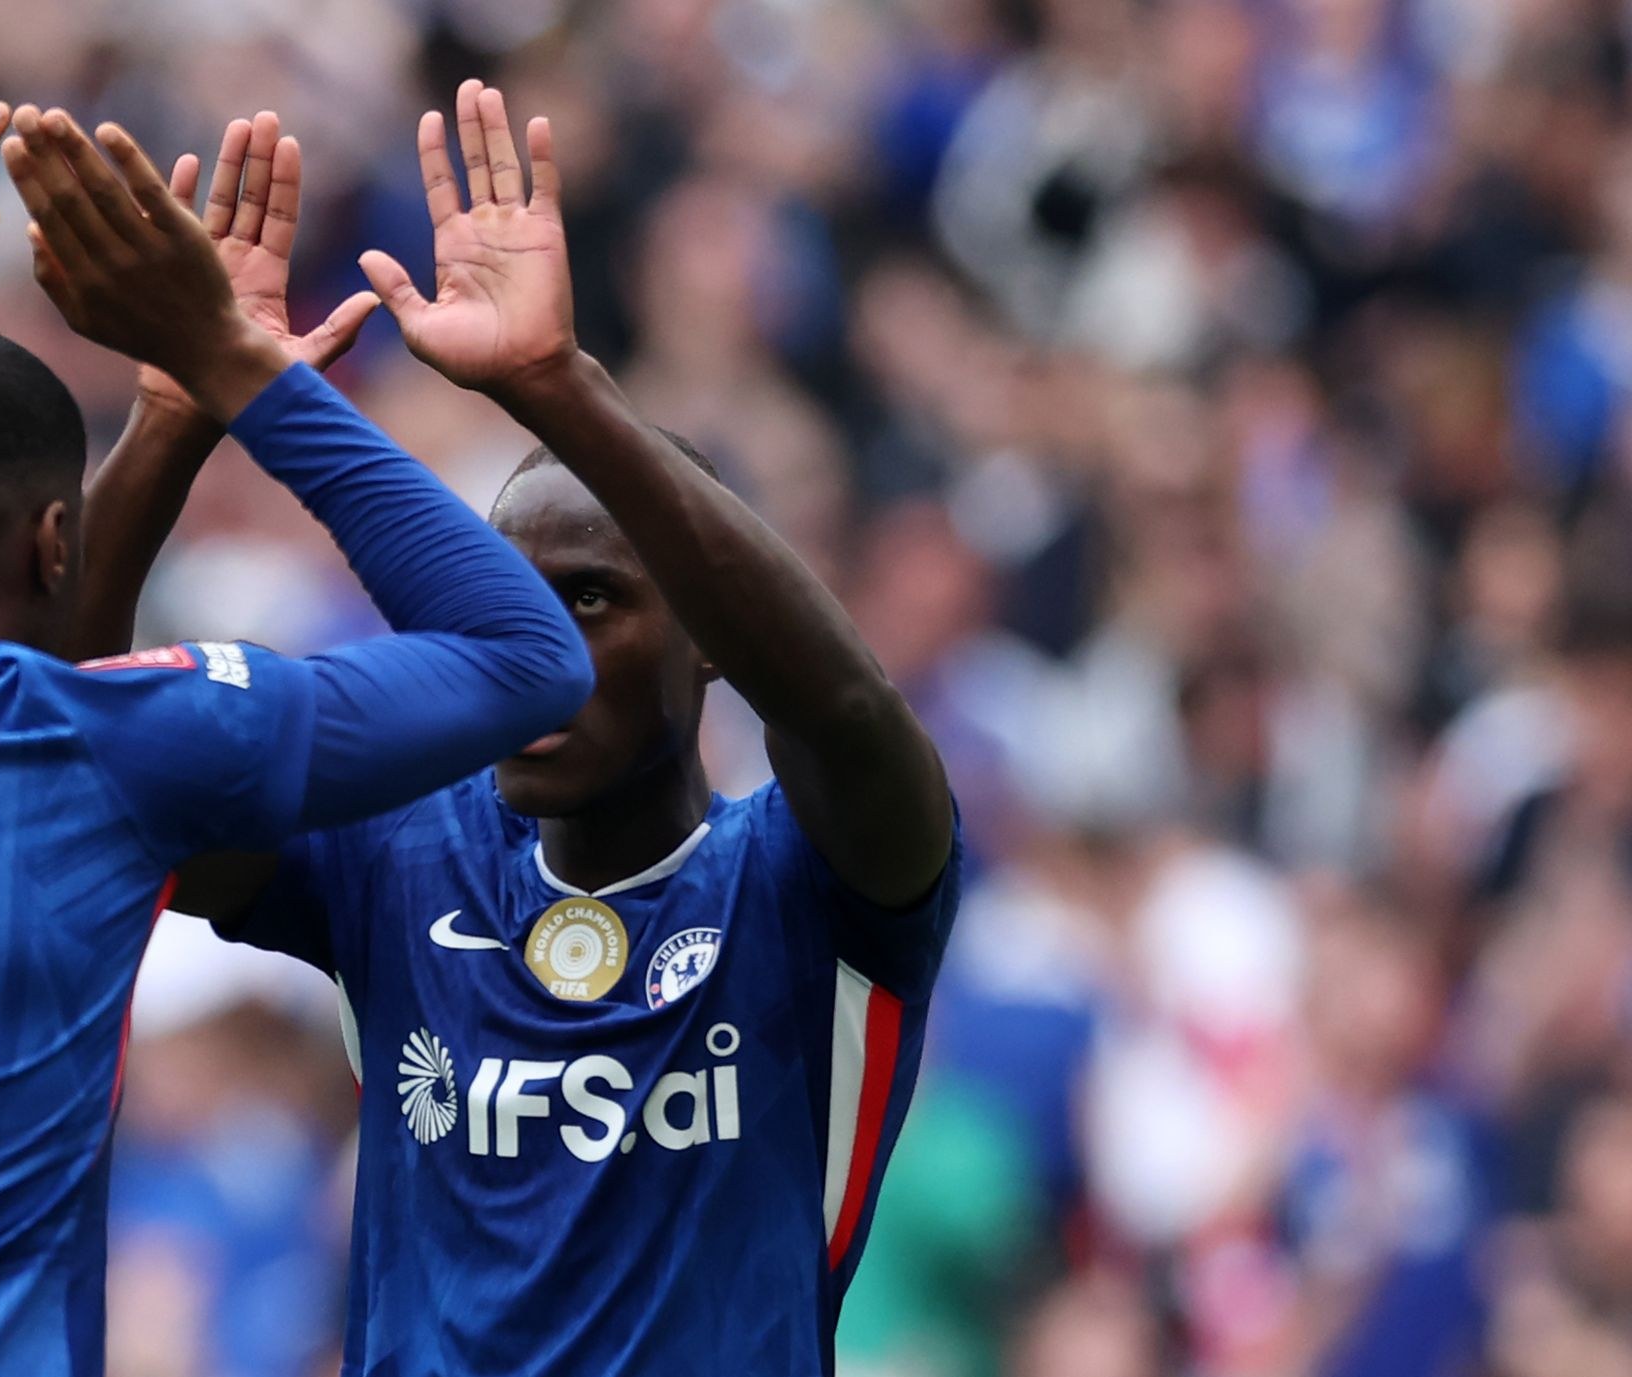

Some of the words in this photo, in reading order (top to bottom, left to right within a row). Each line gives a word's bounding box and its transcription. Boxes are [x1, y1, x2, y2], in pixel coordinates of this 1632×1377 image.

[534, 914, 564, 962] WORLD
[566, 907, 619, 967] CHAMPIONS
[654, 932, 712, 971] CHELSEA
[550, 981, 589, 996] FIFA
[467, 1022, 741, 1163] IFS.ai
